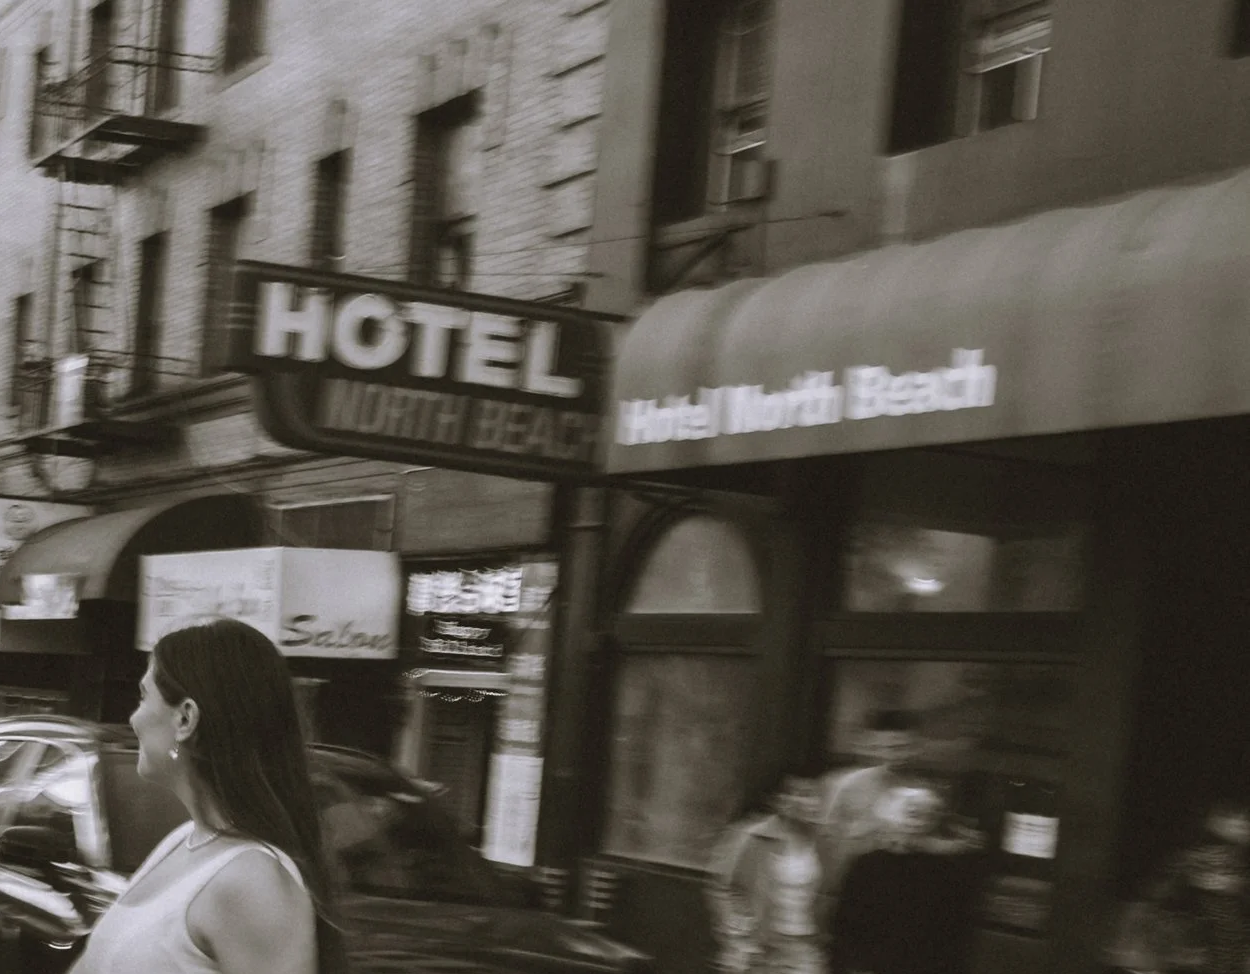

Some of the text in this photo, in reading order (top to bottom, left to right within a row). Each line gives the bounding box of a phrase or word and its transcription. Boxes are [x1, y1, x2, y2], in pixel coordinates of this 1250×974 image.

[256, 281, 584, 398] HOTEL
[322, 378, 469, 445] NORTH
[617, 348, 997, 445] Hotel North Beach
[281, 614, 393, 650] Salon
